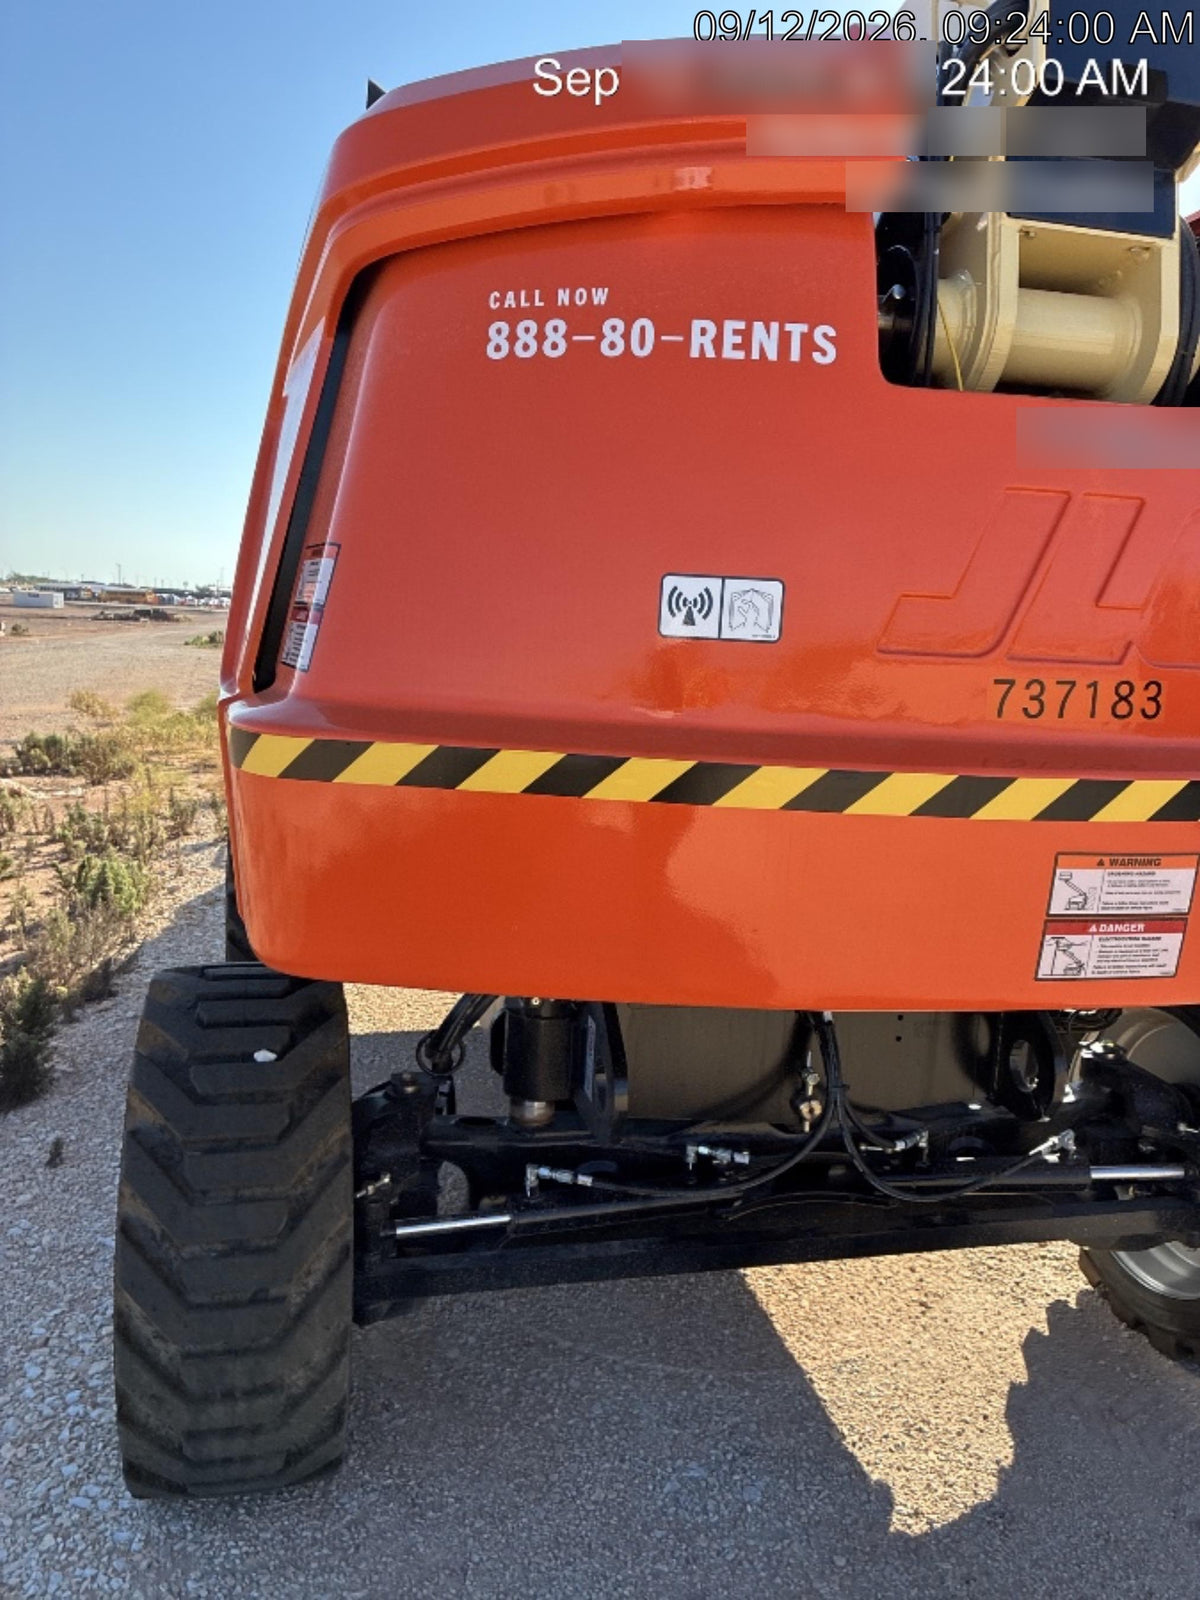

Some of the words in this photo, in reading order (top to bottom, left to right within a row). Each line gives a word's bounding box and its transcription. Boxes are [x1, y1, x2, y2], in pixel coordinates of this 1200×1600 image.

[488, 291, 545, 310] CALL
[557, 287, 609, 307] NOW
[485, 317, 838, 365] 888-80-RENTS
[993, 678, 1163, 720] 737183
[1109, 858, 1161, 867] WARNING
[1098, 923, 1145, 933] DANGER
